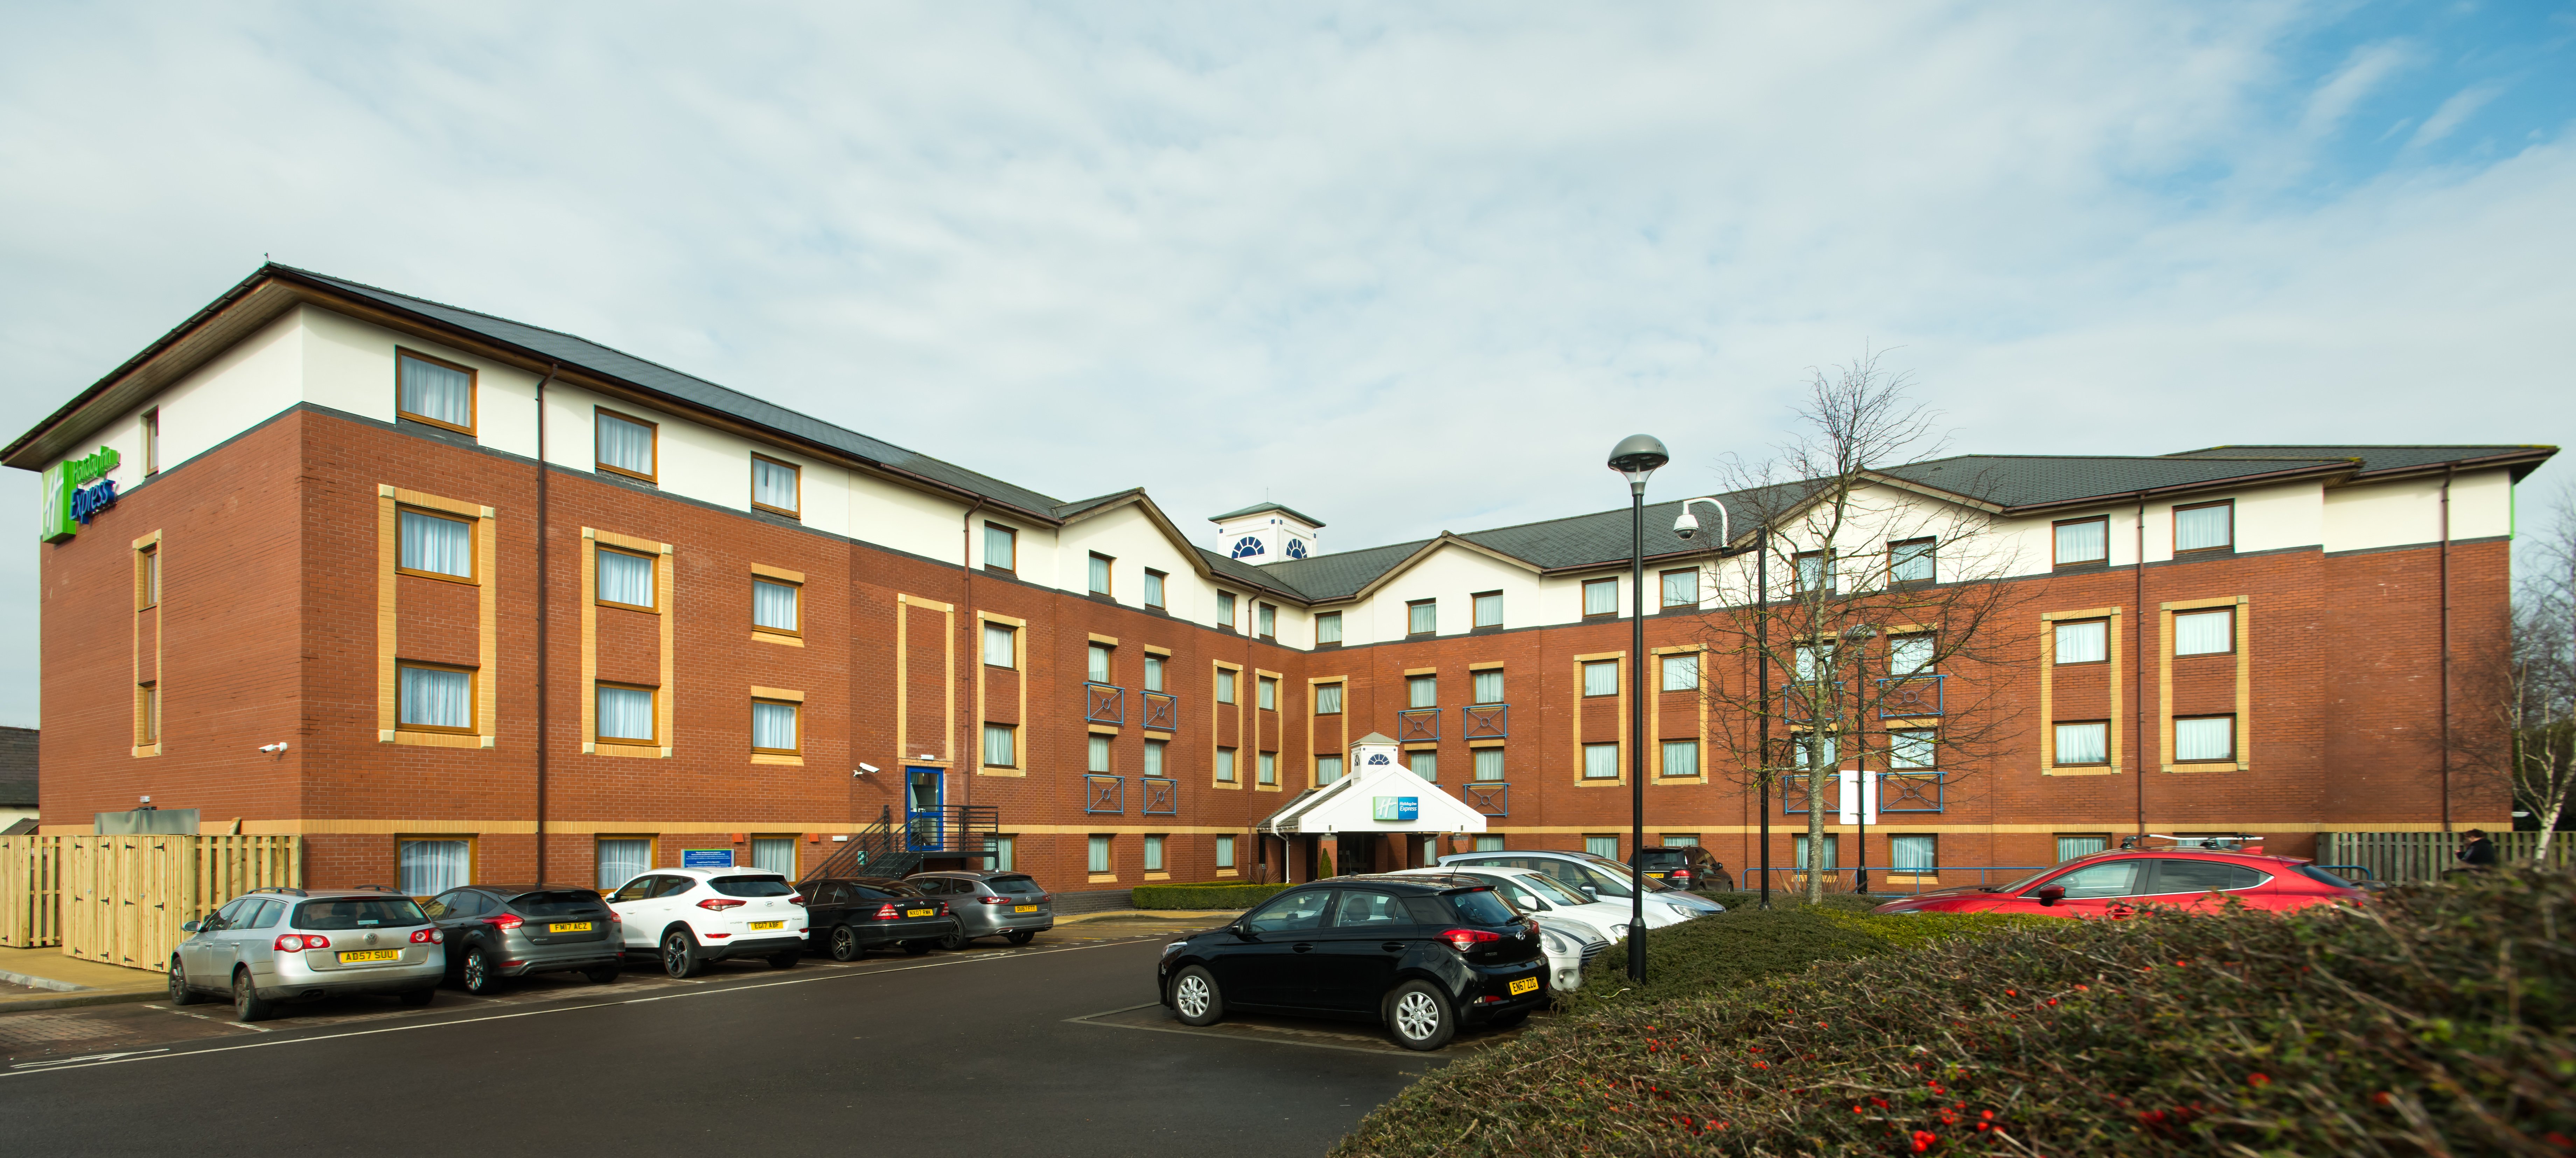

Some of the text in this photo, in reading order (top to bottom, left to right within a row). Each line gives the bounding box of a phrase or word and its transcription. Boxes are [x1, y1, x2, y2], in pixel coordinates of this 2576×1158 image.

[74, 453, 100, 484] Holiday
[70, 479, 111, 524] Express
[346, 951, 371, 961] AD57
[1512, 978, 1536, 992] EN67 ZZG
